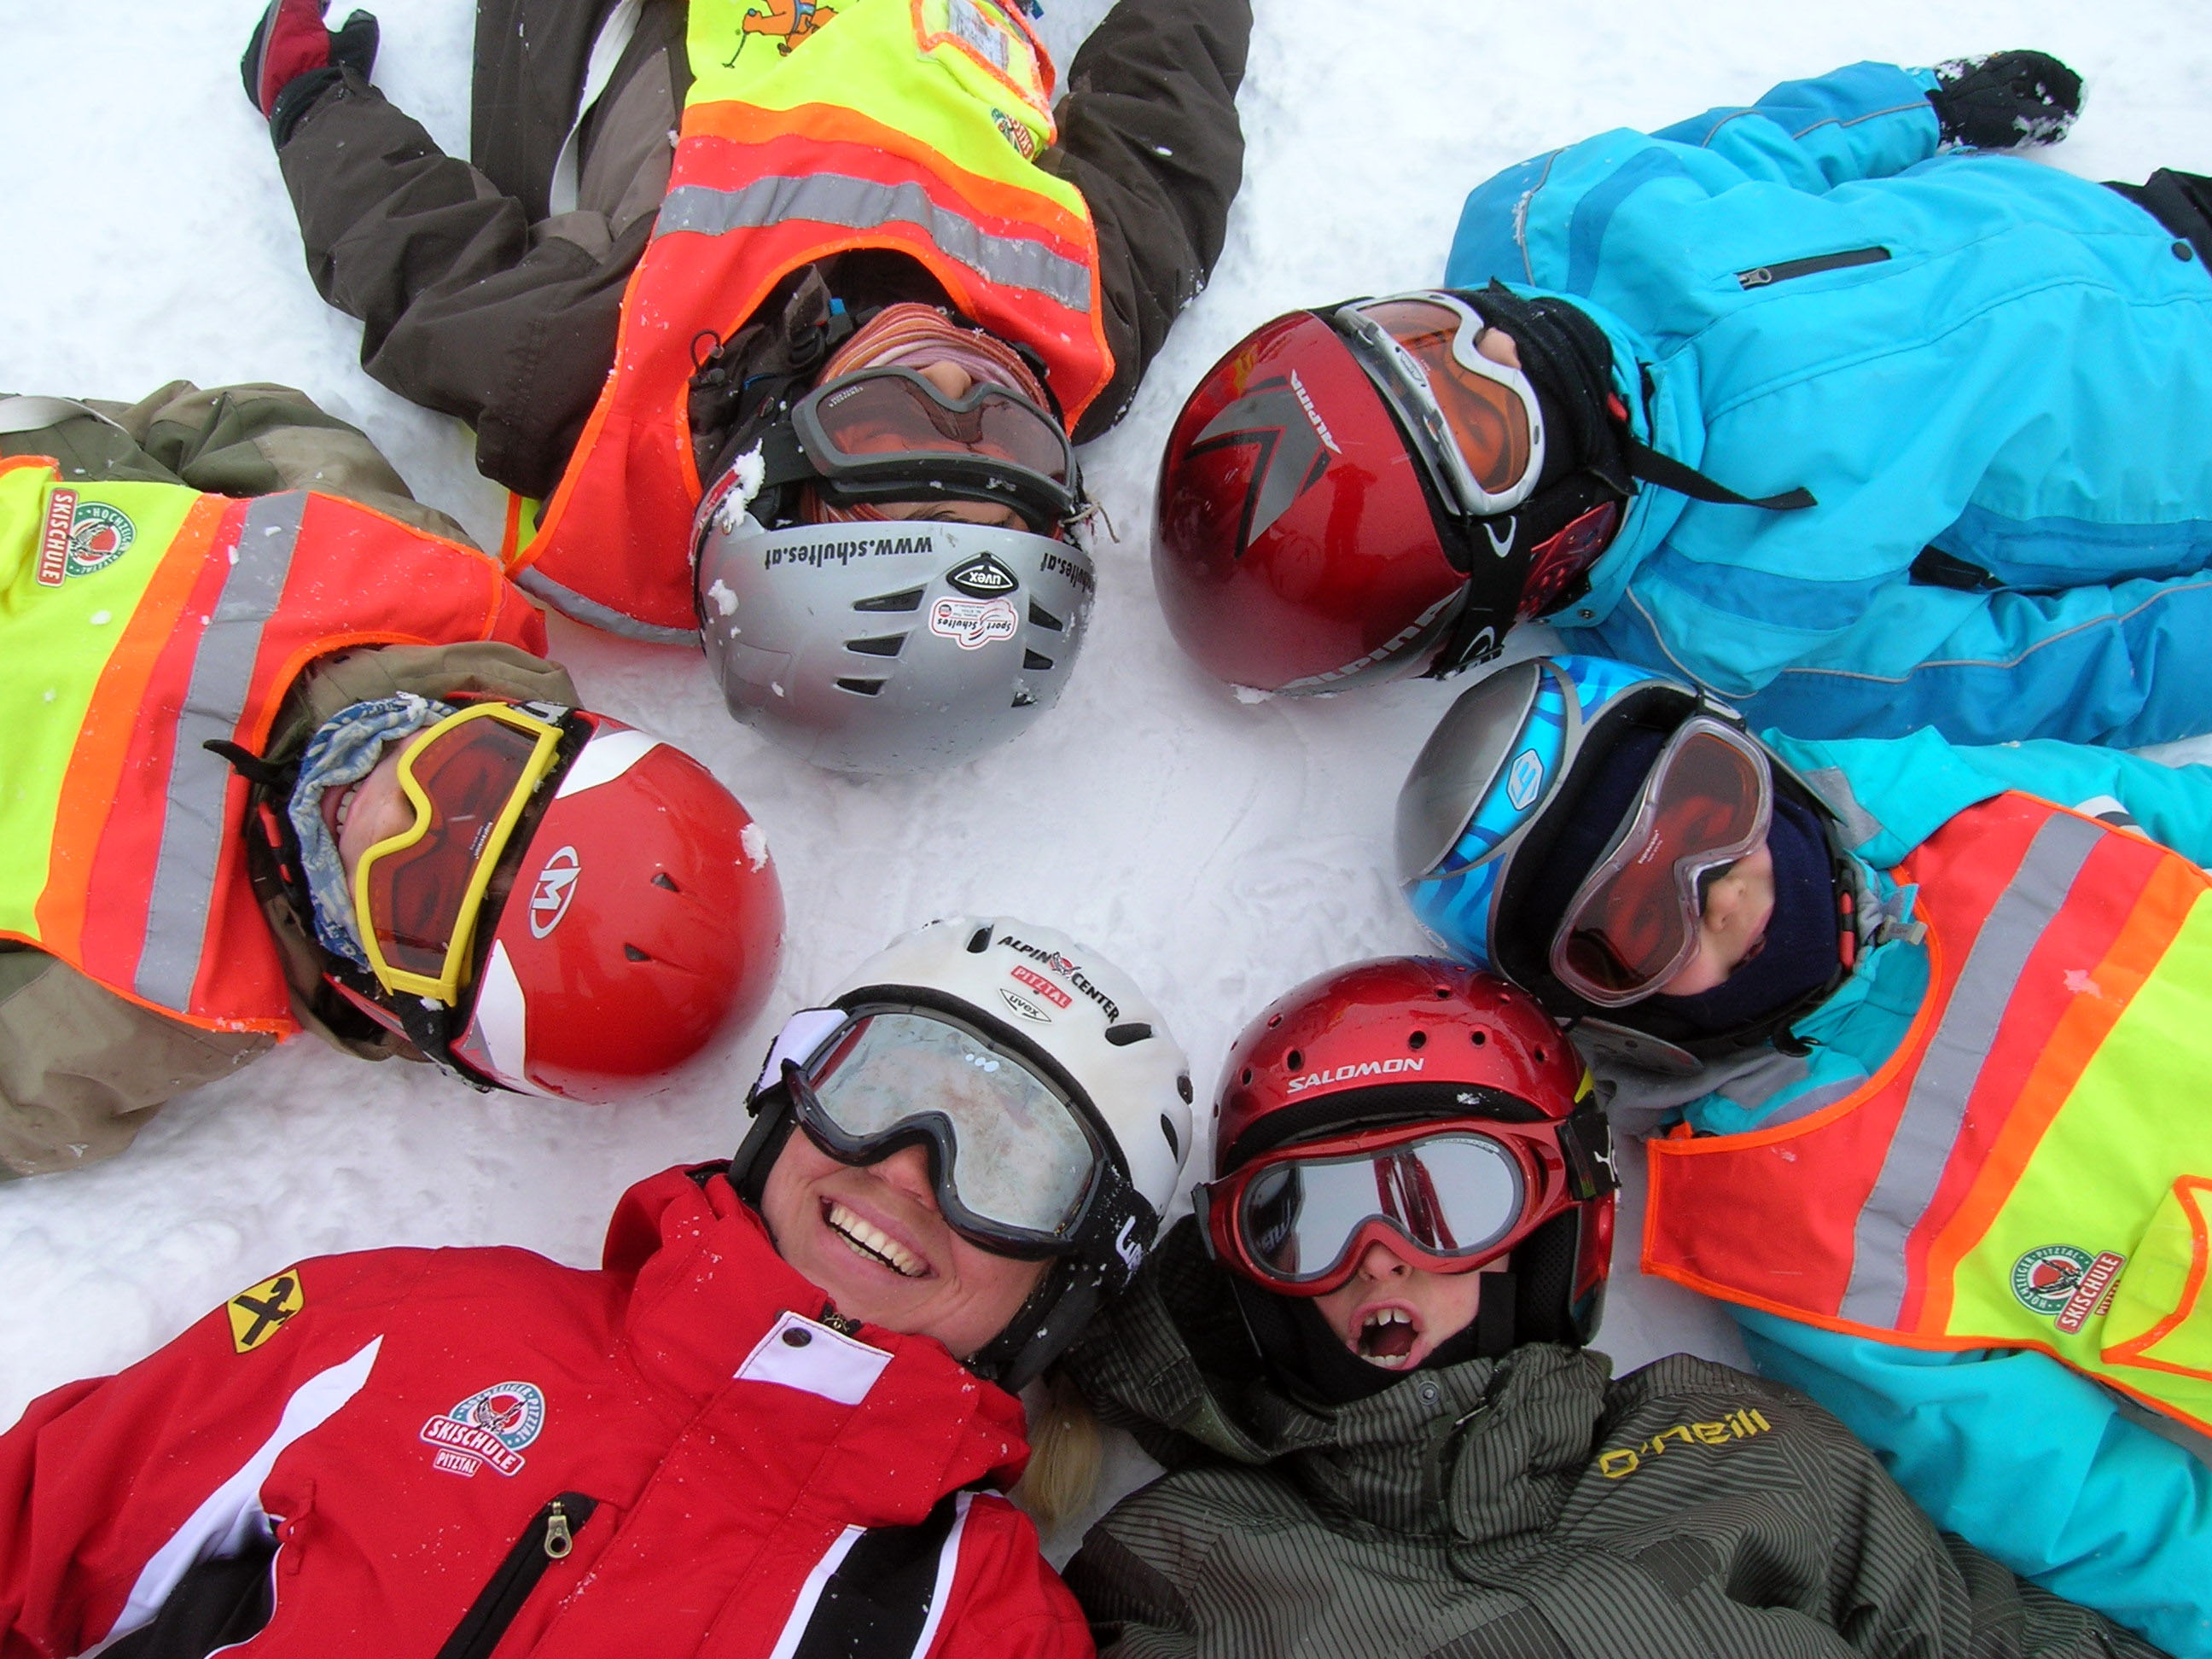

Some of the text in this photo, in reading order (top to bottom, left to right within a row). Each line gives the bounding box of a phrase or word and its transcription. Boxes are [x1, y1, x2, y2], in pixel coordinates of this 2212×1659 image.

[1290, 368, 1342, 454] ALPINA
[42, 493, 73, 580] SKISCHULE
[765, 537, 933, 569] www.schultes.at
[969, 572, 1001, 585] uvex
[938, 618, 1011, 632] Sport Schultes
[1283, 586, 1462, 689] ALPINA
[997, 935, 1120, 1023] ALPIN CENTER
[1015, 967, 1068, 1005] PITZTAL
[1010, 996, 1039, 1016] uvex
[1287, 1058, 1424, 1094] SALOMON
[2035, 1247, 2079, 1259] PITZTAL
[2016, 1255, 2047, 1308] HOCHZEIGER
[2061, 1255, 2119, 1327] SKISCHULE
[516, 1398, 539, 1441] PITZTAL
[428, 1420, 516, 1470] SKISCHULE
[436, 1452, 478, 1473] PITZTAL
